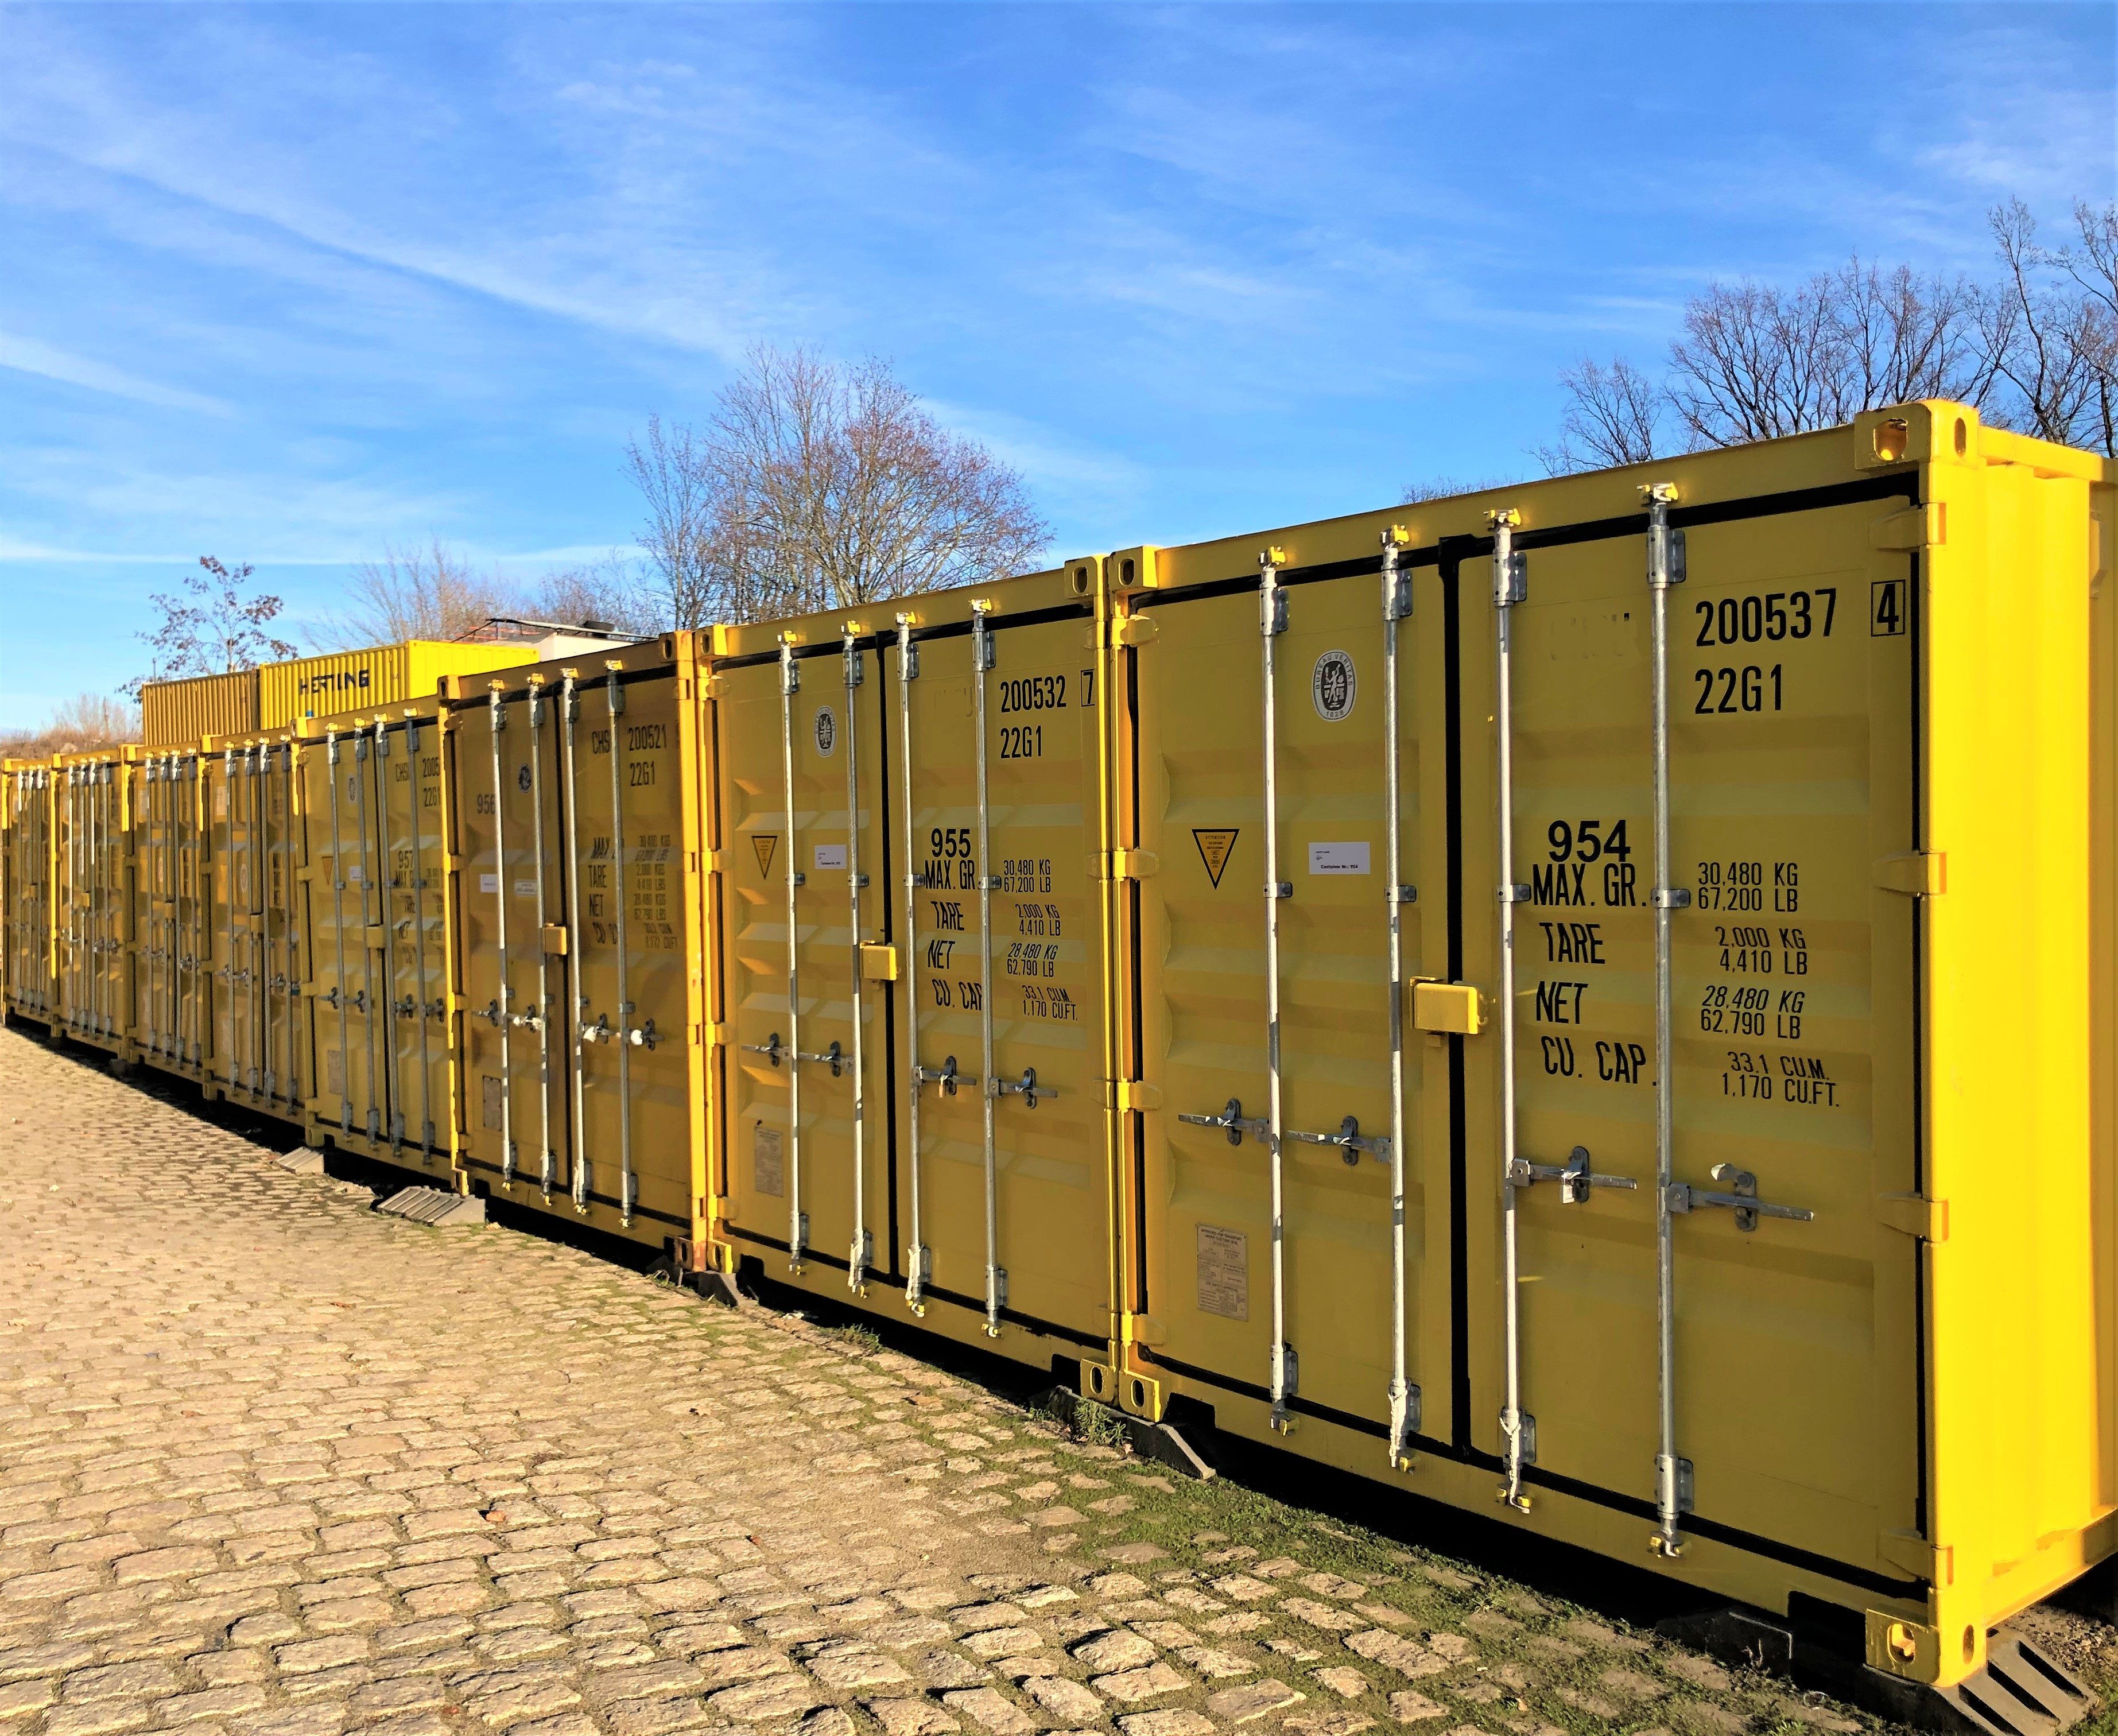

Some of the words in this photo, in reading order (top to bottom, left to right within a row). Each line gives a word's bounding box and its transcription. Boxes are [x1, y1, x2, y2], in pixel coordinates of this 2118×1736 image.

[1694, 588, 1837, 647] 200537
[1876, 583, 1900, 633] 4
[1000, 675, 1067, 713] 200532
[1083, 671, 1093, 704] 7
[1694, 664, 1782, 715] 22G1
[628, 723, 668, 751] 200521
[1000, 725, 1041, 759] 22G1
[630, 761, 655, 786] 22G1
[931, 828, 971, 858] 955
[1548, 819, 1631, 863] 954
[1039, 859, 1051, 875] KG
[1774, 862, 1798, 886] KG
[1039, 877, 1051, 893] LB
[1533, 863, 1595, 906] MAX.
[1604, 863, 1647, 907] GR.
[1045, 904, 1060, 919] KG
[1775, 888, 1798, 912] LB
[930, 901, 965, 931] TARE
[1049, 920, 1061, 936] LB
[1044, 944, 1058, 960] KG
[1539, 922, 1605, 965] TARE
[1779, 928, 1807, 950] KG
[928, 939, 956, 970] NET
[1784, 951, 1807, 975] LB
[1043, 960, 1054, 978] LB
[932, 978, 955, 1008] CU.
[1535, 980, 1588, 1025] NET
[1778, 990, 1806, 1014] KG
[1777, 1014, 1801, 1039] LB
[1541, 1036, 1582, 1079] CU.
[1595, 1041, 1657, 1086] CAP.
[1727, 1051, 1768, 1074] 33.1
